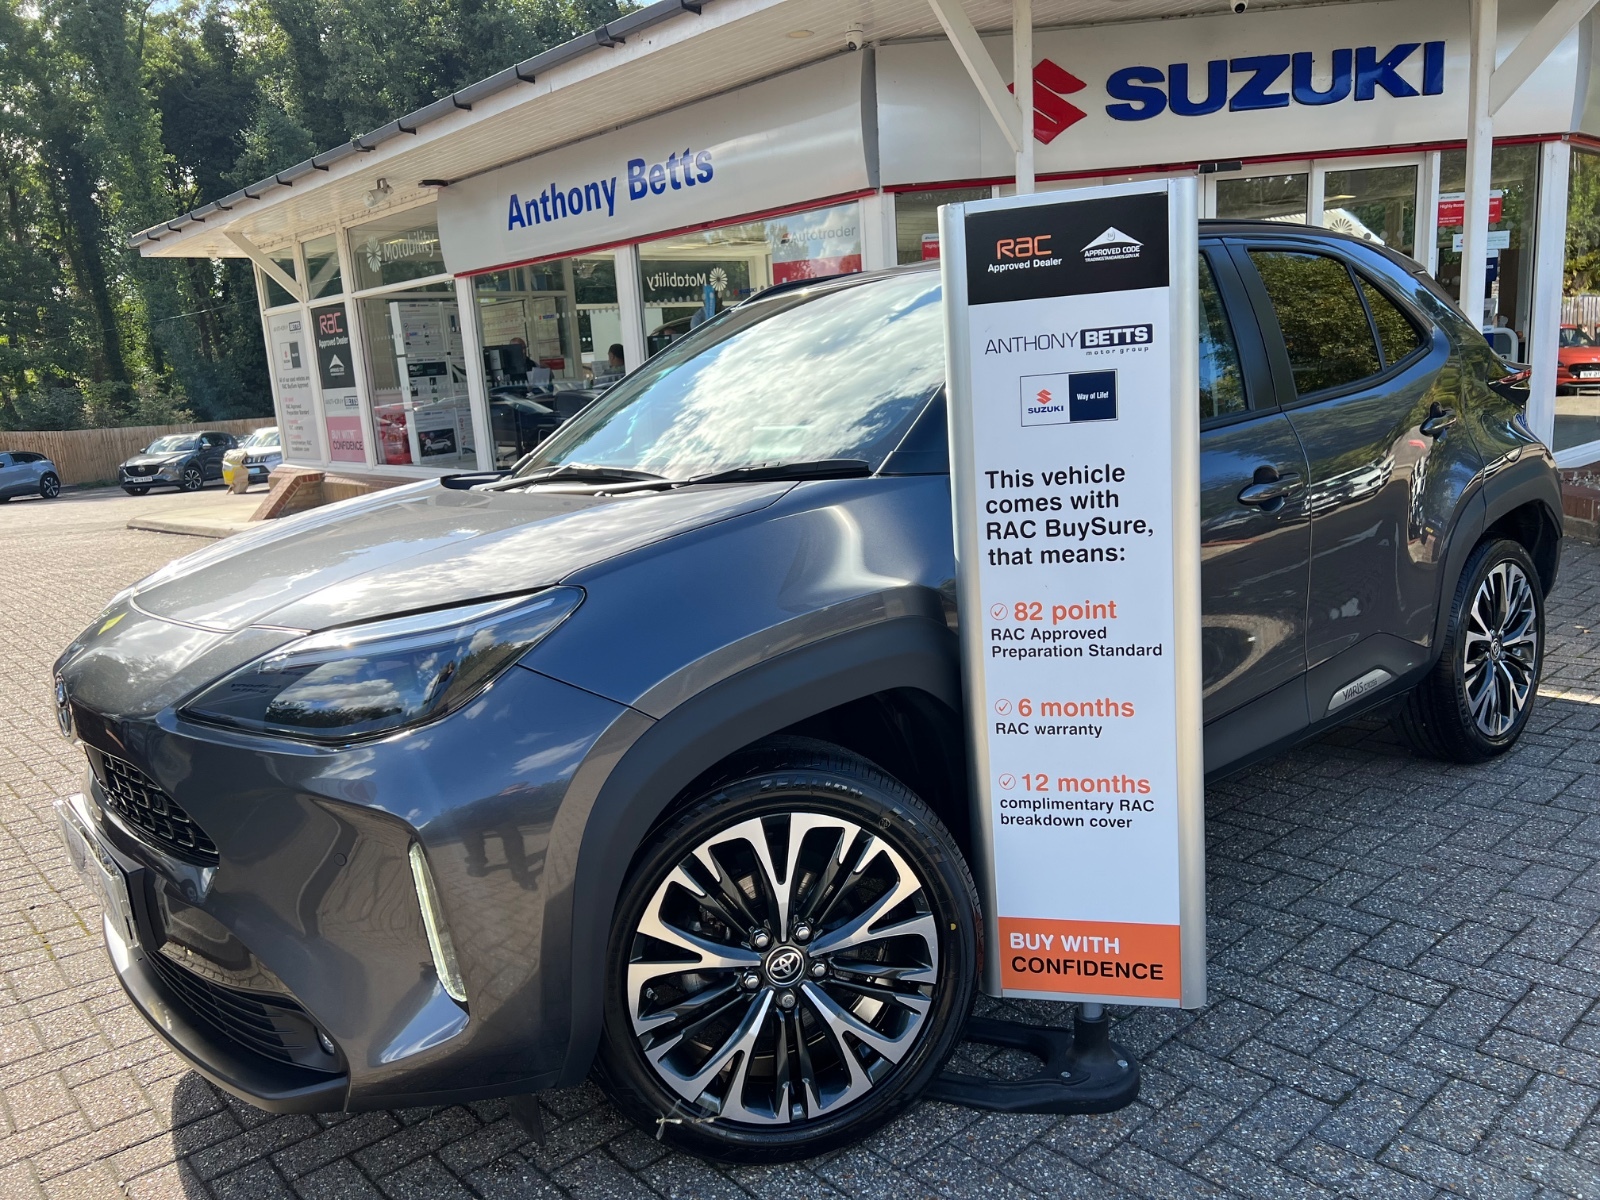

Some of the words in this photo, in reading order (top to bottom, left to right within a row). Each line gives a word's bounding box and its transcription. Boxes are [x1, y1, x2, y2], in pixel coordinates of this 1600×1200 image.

[1105, 40, 1446, 122] SUZUKI
[507, 177, 617, 231] Anthony
[627, 148, 714, 201] Betts
[790, 226, 856, 244] Autotrader
[383, 230, 437, 262] Motability
[995, 233, 1053, 260] RAC
[1084, 247, 1121, 258] APPROVED
[1122, 245, 1141, 254] CODE
[987, 260, 1031, 274] Approved
[1033, 256, 1063, 269] Dealer
[319, 312, 343, 335] RAC
[318, 339, 336, 349] Approved
[335, 335, 349, 346] Dealer
[984, 331, 1079, 355] ANTHONY
[1084, 326, 1149, 347] BETTS
[1119, 346, 1149, 355] group
[1076, 392, 1089, 401] Way
[1089, 392, 1096, 400] of
[1096, 391, 1109, 400] Life!
[1027, 405, 1065, 415] SUZUKI
[332, 441, 364, 451] CONFIDENCE
[985, 469, 1035, 490] This
[1041, 463, 1126, 487] vehicle
[985, 494, 1063, 515] comes
[1070, 489, 1120, 510] with
[986, 520, 1037, 541] RAC
[1045, 515, 1155, 542] BuySure,
[988, 547, 1034, 567] that
[1040, 544, 1126, 566] means:
[1013, 600, 1044, 622] 82
[1051, 600, 1118, 626] point
[991, 627, 1026, 642] RAC
[1030, 626, 1107, 642] Approved
[991, 644, 1083, 661] Preparation
[1088, 642, 1163, 658] Standard
[1342, 682, 1364, 701] YARIS
[1018, 698, 1033, 718] 6
[1040, 697, 1136, 718] months
[995, 722, 1030, 736] RAC
[1034, 723, 1103, 739] warranty
[1021, 773, 1050, 792] 12
[1057, 774, 1152, 795] months
[1000, 796, 1115, 814] complimentary
[1119, 799, 1155, 813] RAC
[1000, 813, 1085, 829] breakdown
[1089, 817, 1134, 829] cover
[1009, 932, 1054, 951] BUY
[1060, 934, 1120, 955] WITH
[1011, 956, 1165, 981] CONFIDENCE
